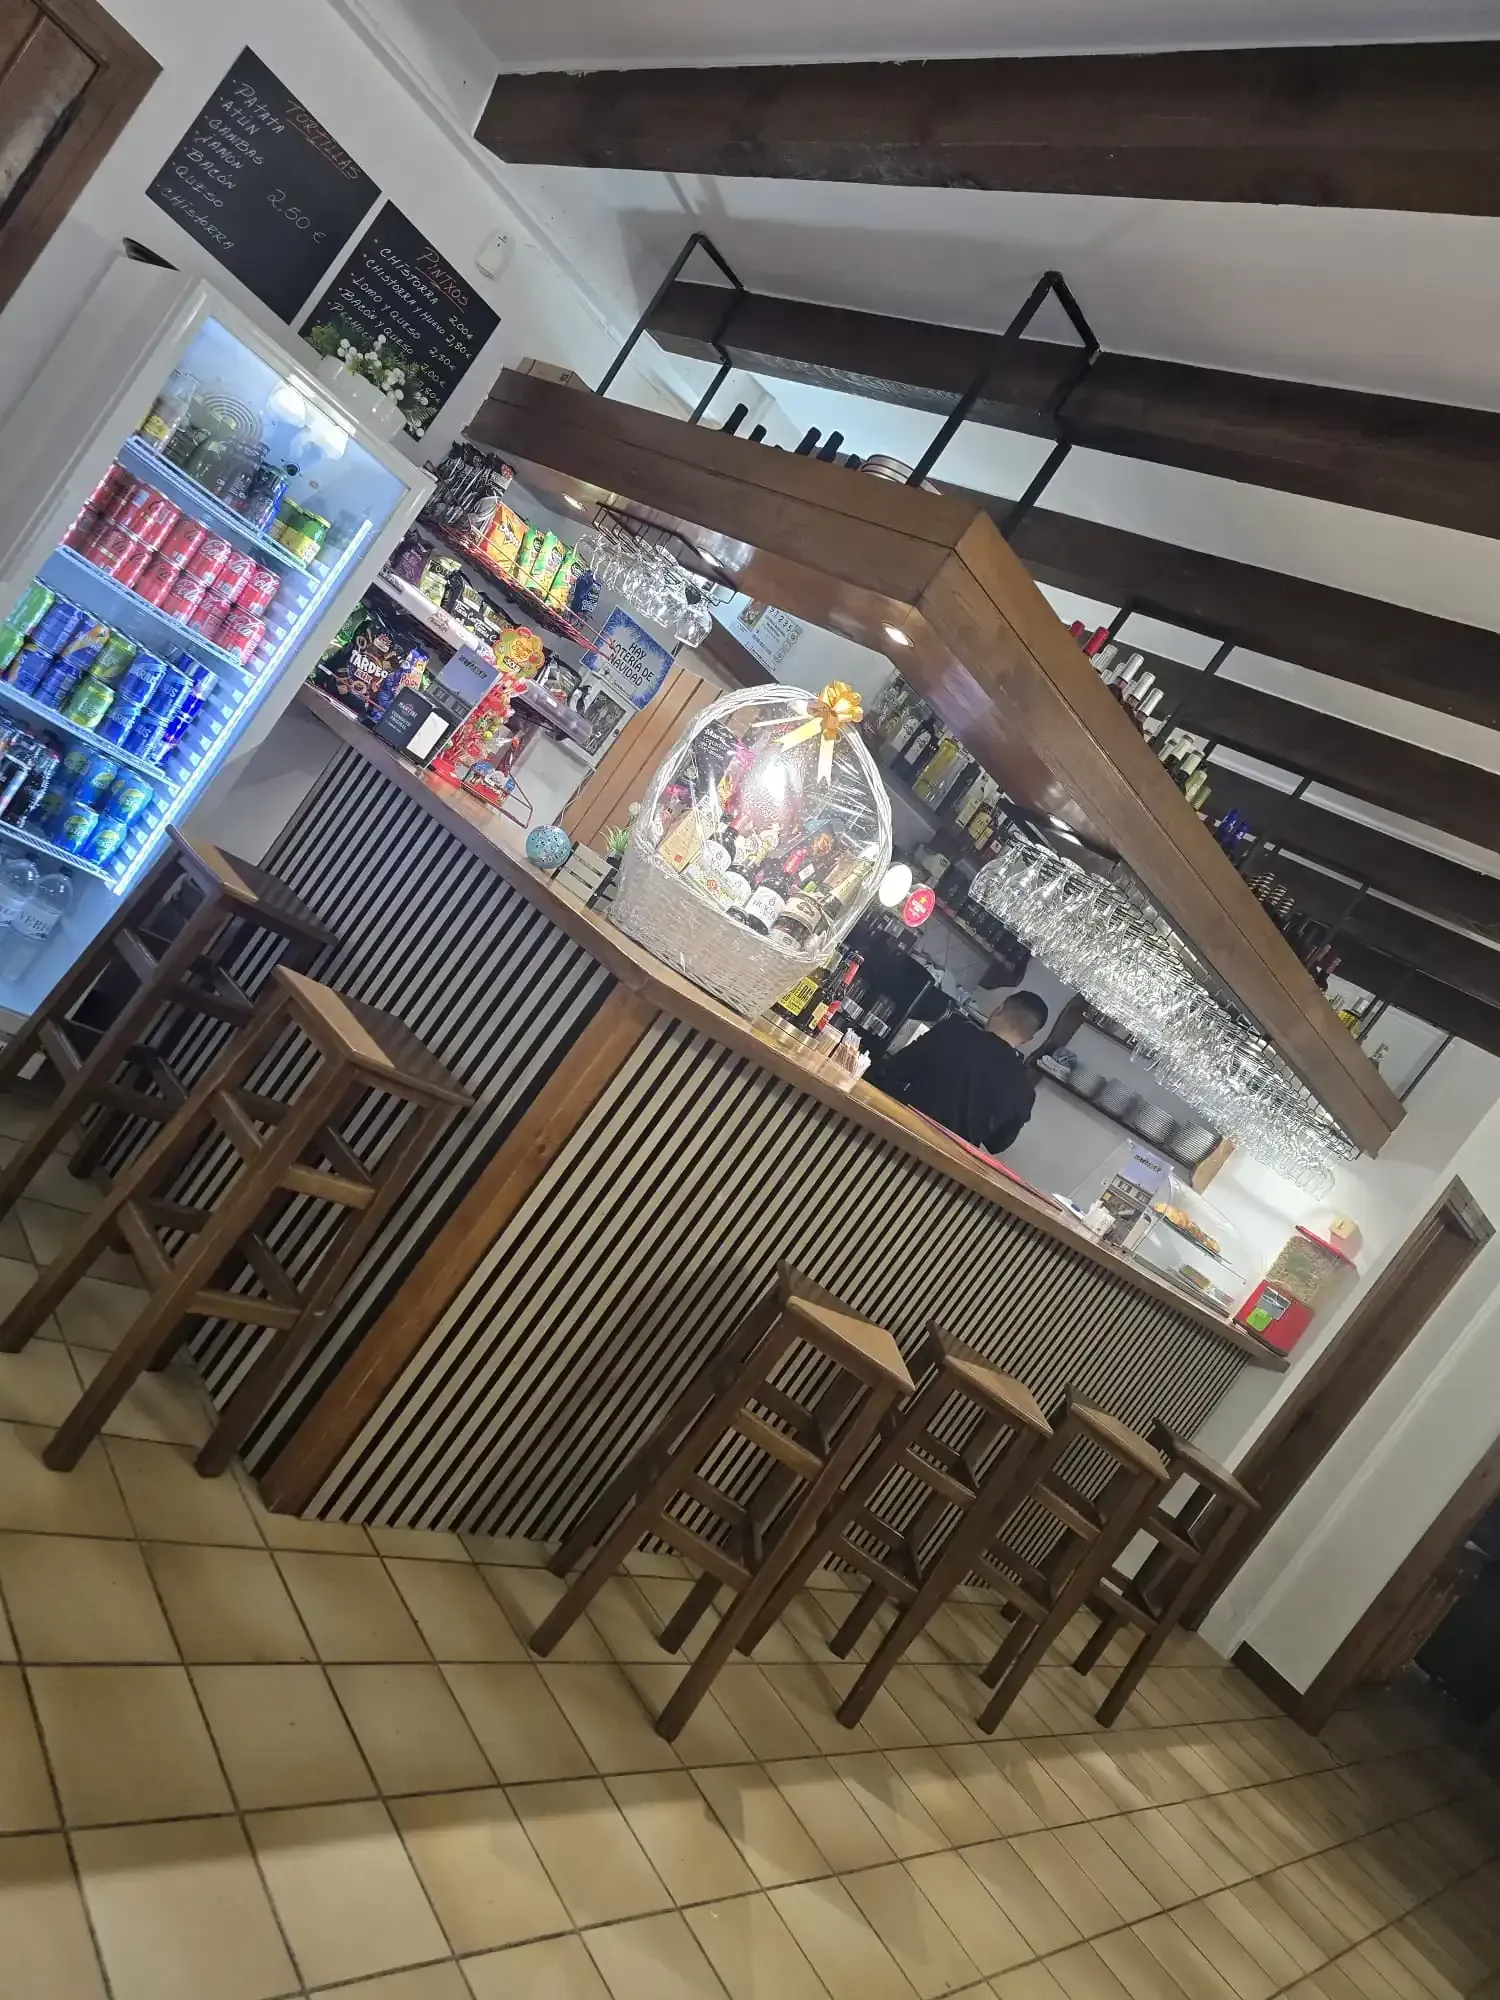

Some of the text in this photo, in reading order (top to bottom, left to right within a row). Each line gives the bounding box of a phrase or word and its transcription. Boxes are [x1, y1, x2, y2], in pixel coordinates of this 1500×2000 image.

[234, 83, 285, 133] PATATA
[208, 119, 264, 165] GAMBAS
[286, 100, 361, 179] TORTILLAS
[175, 165, 224, 208] QUESO
[186, 148, 236, 189] BACÓN
[366, 259, 416, 306] CHISTORRA
[380, 248, 439, 305] CHISTORRA
[417, 246, 470, 306] PINTXOS
[352, 275, 383, 303] LOMO
[390, 310, 421, 340] QUESO
[384, 327, 414, 356] QUESO
[350, 650, 389, 679] TARDEO
[608, 653, 643, 687] NAVIDAD
[628, 642, 647, 660] HAY
[642, 667, 655, 682] DE
